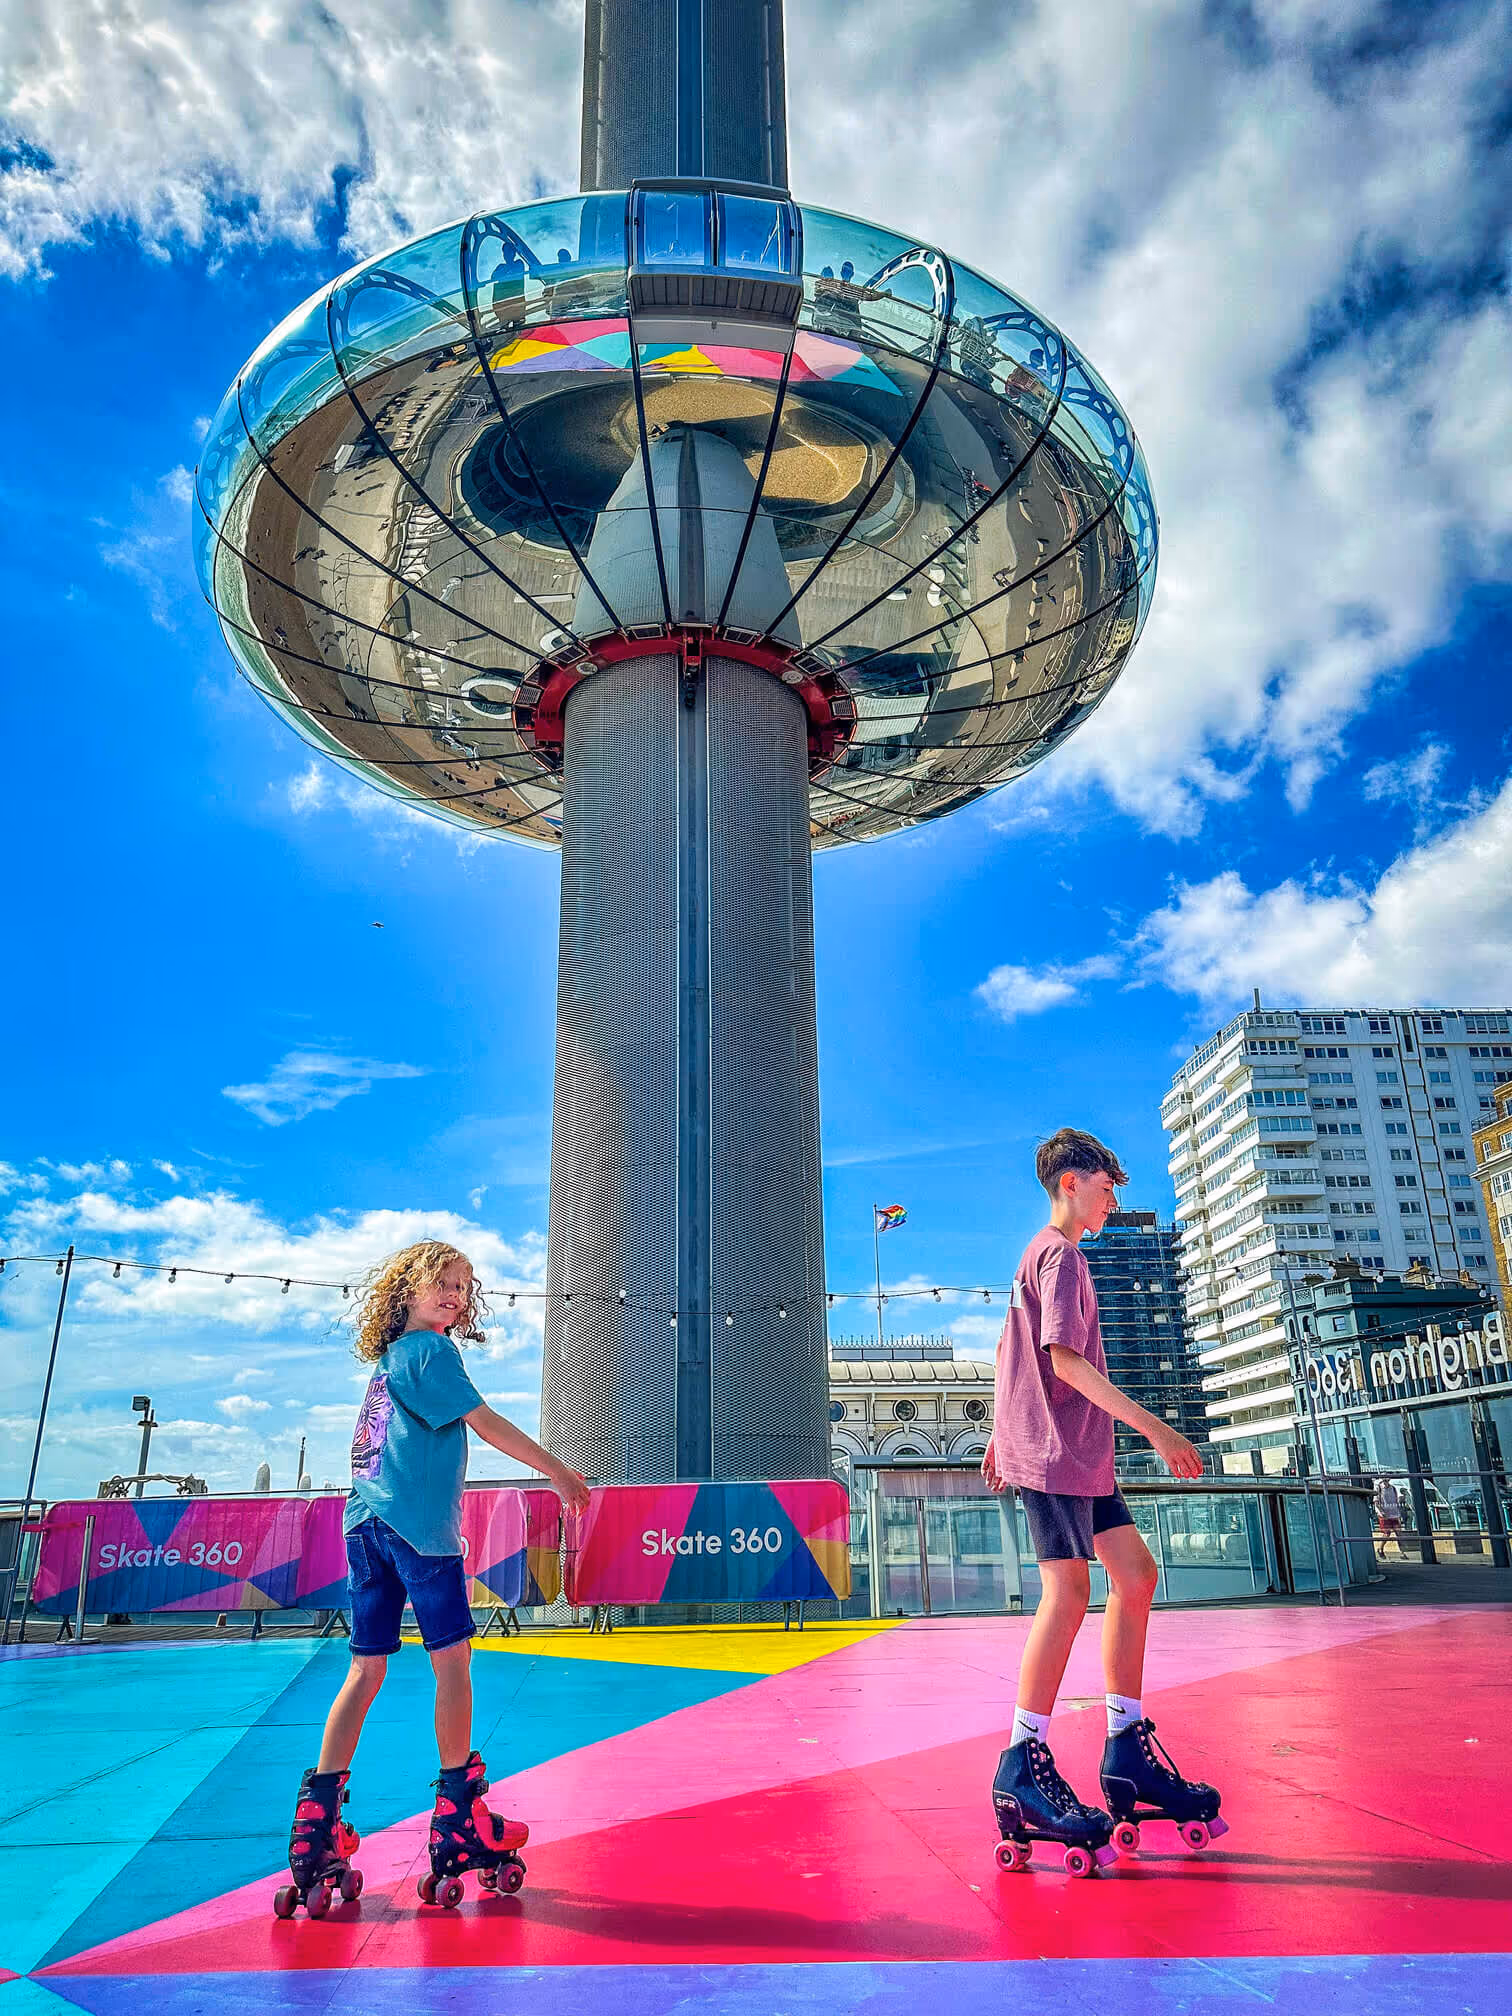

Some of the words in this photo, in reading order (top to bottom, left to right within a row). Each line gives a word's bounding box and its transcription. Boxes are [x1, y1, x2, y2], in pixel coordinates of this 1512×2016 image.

[99, 1543, 181, 1569] Skate
[189, 1541, 243, 1566] 360
[642, 1528, 722, 1556] Skate
[730, 1527, 782, 1554] 360
